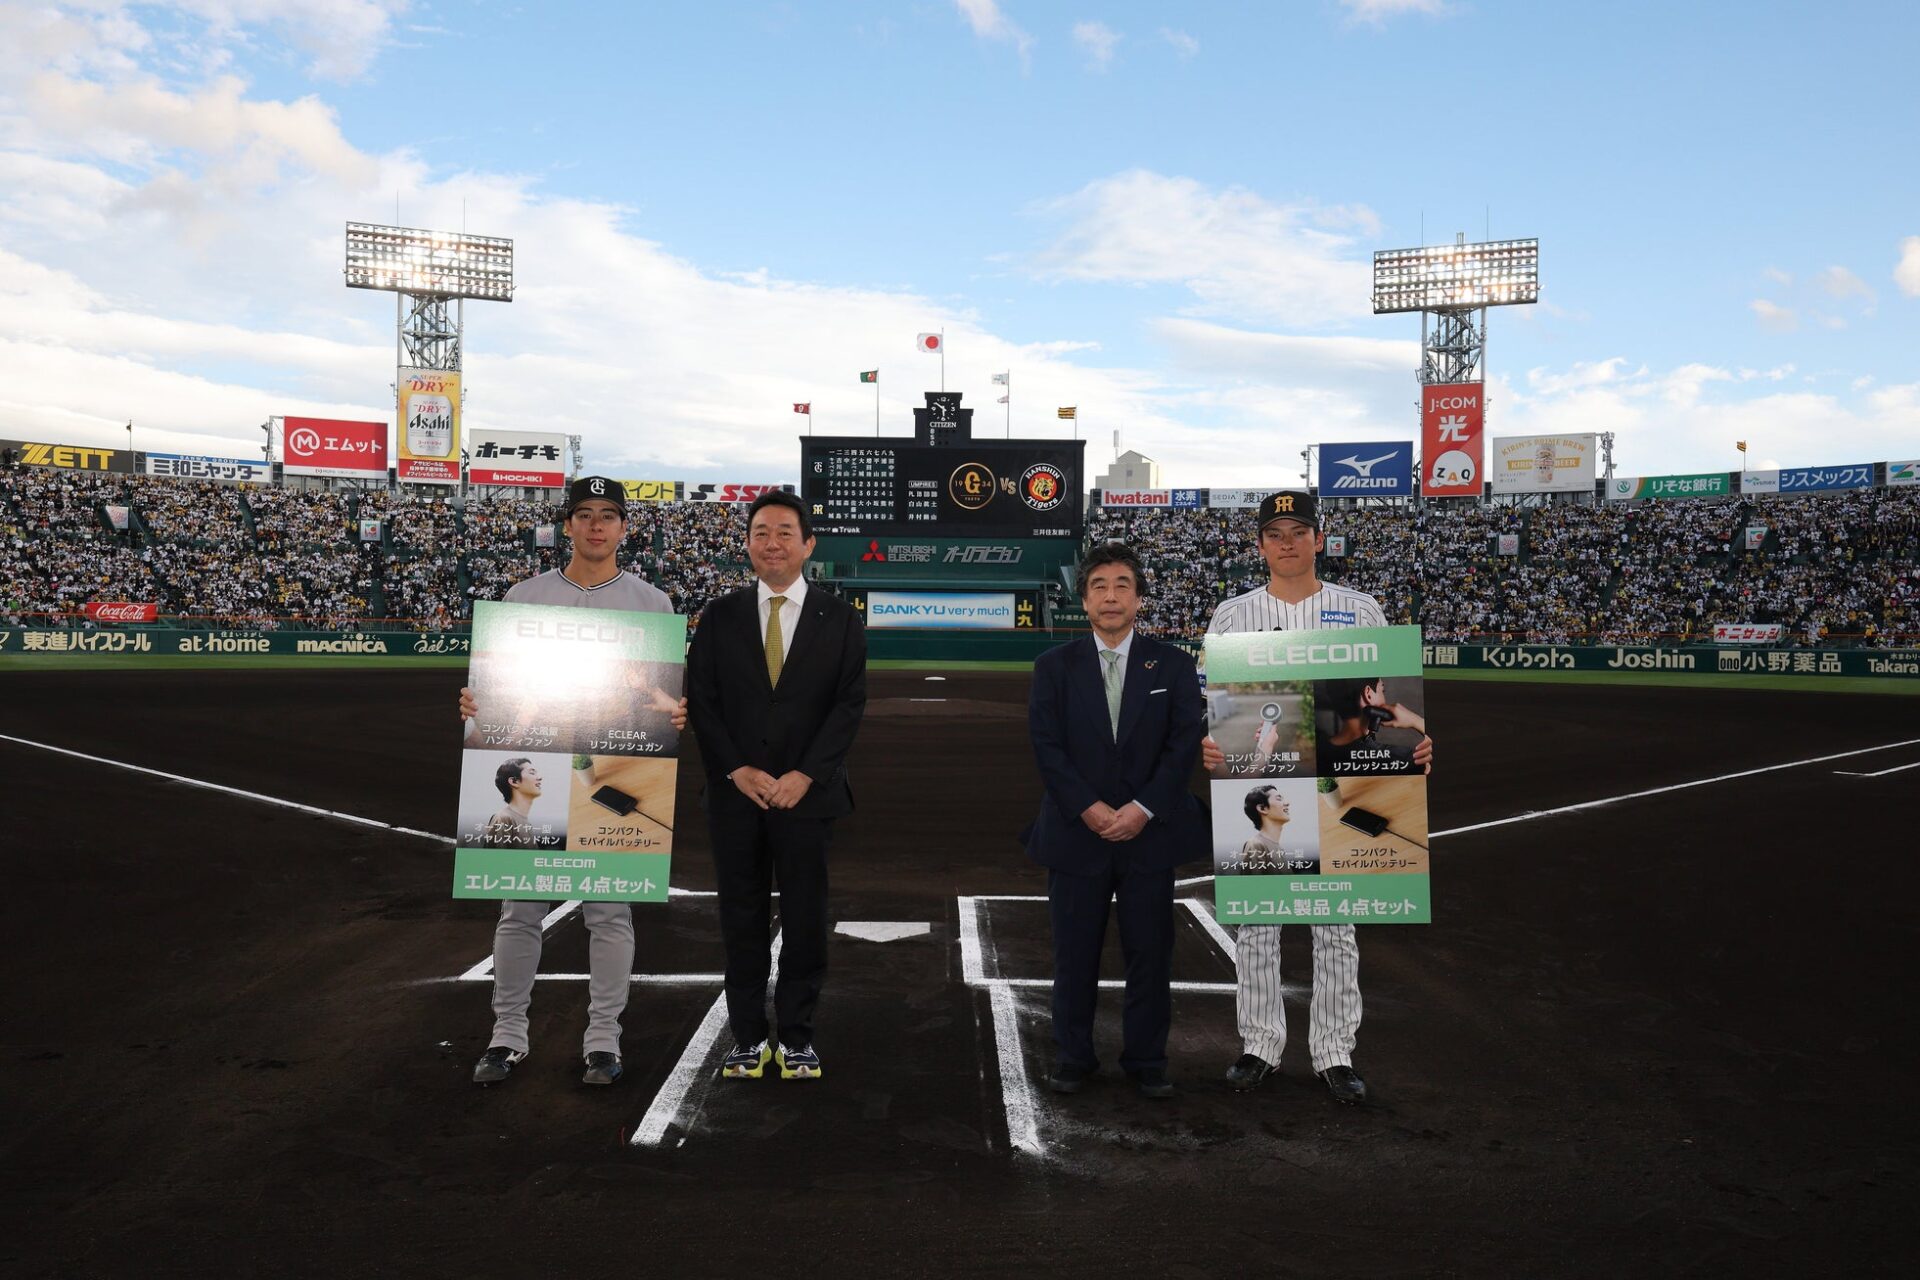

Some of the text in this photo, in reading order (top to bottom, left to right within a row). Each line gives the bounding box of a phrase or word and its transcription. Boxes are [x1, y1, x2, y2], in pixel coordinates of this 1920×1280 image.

[1430, 397, 1476, 412] J:COM
[410, 414, 449, 430] Asahi
[1439, 415, 1470, 442] 光
[324, 437, 382, 454] エムット
[475, 442, 560, 460] ホーチキ
[21, 443, 115, 470] ZETT
[154, 459, 262, 479] 三和シャッター
[1025, 466, 1060, 479] HANSHIN
[1782, 468, 1869, 487] シスメックス
[1652, 478, 1721, 492] りそな銀行
[1105, 491, 1169, 504] Iwatani
[1175, 490, 1196, 501] 水素
[1027, 496, 1058, 508] Tigers
[888, 545, 937, 553] MITSUBISHI
[888, 554, 930, 562] ELECTRIC
[872, 604, 1009, 618] SANKYU very much
[1322, 613, 1354, 622] Joshin
[1715, 628, 1779, 639] 不二サッシ
[23, 631, 151, 651] 東進ハイスクール
[1248, 643, 1378, 666] ELECOM
[1483, 647, 1574, 668] Kubota
[1608, 649, 1695, 668] Joshin
[1743, 652, 1841, 672] 小野薬品
[1867, 658, 1919, 673] Takara
[485, 735, 552, 747] ハンディファン
[608, 730, 647, 740] ECLEAR
[590, 741, 663, 752] リフレッシュガン
[1226, 751, 1300, 763] コンパクト大風量
[1350, 750, 1391, 759] ECLEAR
[1230, 764, 1296, 774] ハンディファン
[1333, 761, 1409, 772] リフレッシュガン
[475, 823, 552, 834] オープンイヤー型
[598, 826, 643, 836] コンパクト
[464, 834, 560, 846] ワイヤレスヘッドホン
[578, 837, 661, 848] モバイルバッテリー
[1350, 848, 1398, 857] コンパクト
[534, 857, 596, 868] ELECOM
[1220, 860, 1313, 870] ワイヤレスヘッドホン
[1331, 858, 1418, 869] モバイルバッテリー
[464, 875, 656, 894] エレコム製品 4点セット
[1290, 881, 1352, 892] ELECOM
[1226, 898, 1417, 916] エレコム製品 4点セット
